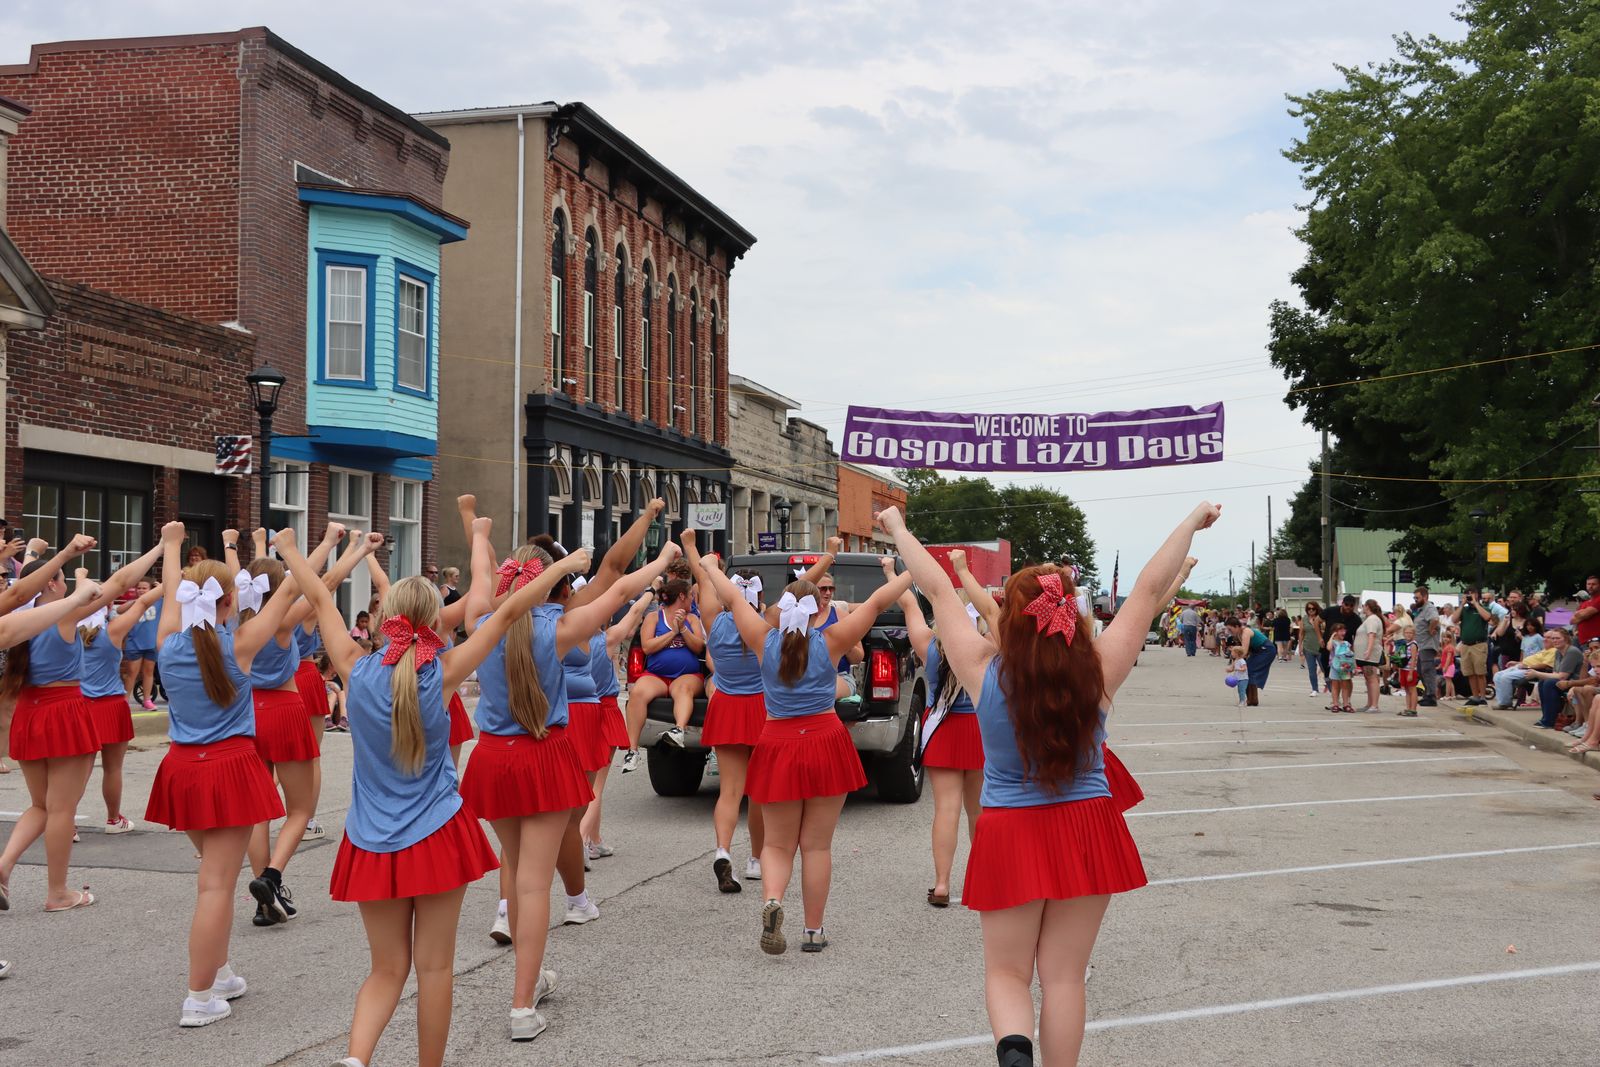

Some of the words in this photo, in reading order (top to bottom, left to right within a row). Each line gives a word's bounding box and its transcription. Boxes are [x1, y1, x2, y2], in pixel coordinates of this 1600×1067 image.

[974, 415, 1060, 437] WELCOME
[1066, 415, 1088, 436] TO
[847, 431, 1006, 466] Gosport
[1016, 439, 1107, 467] Lazy
[1118, 431, 1223, 462] Days
